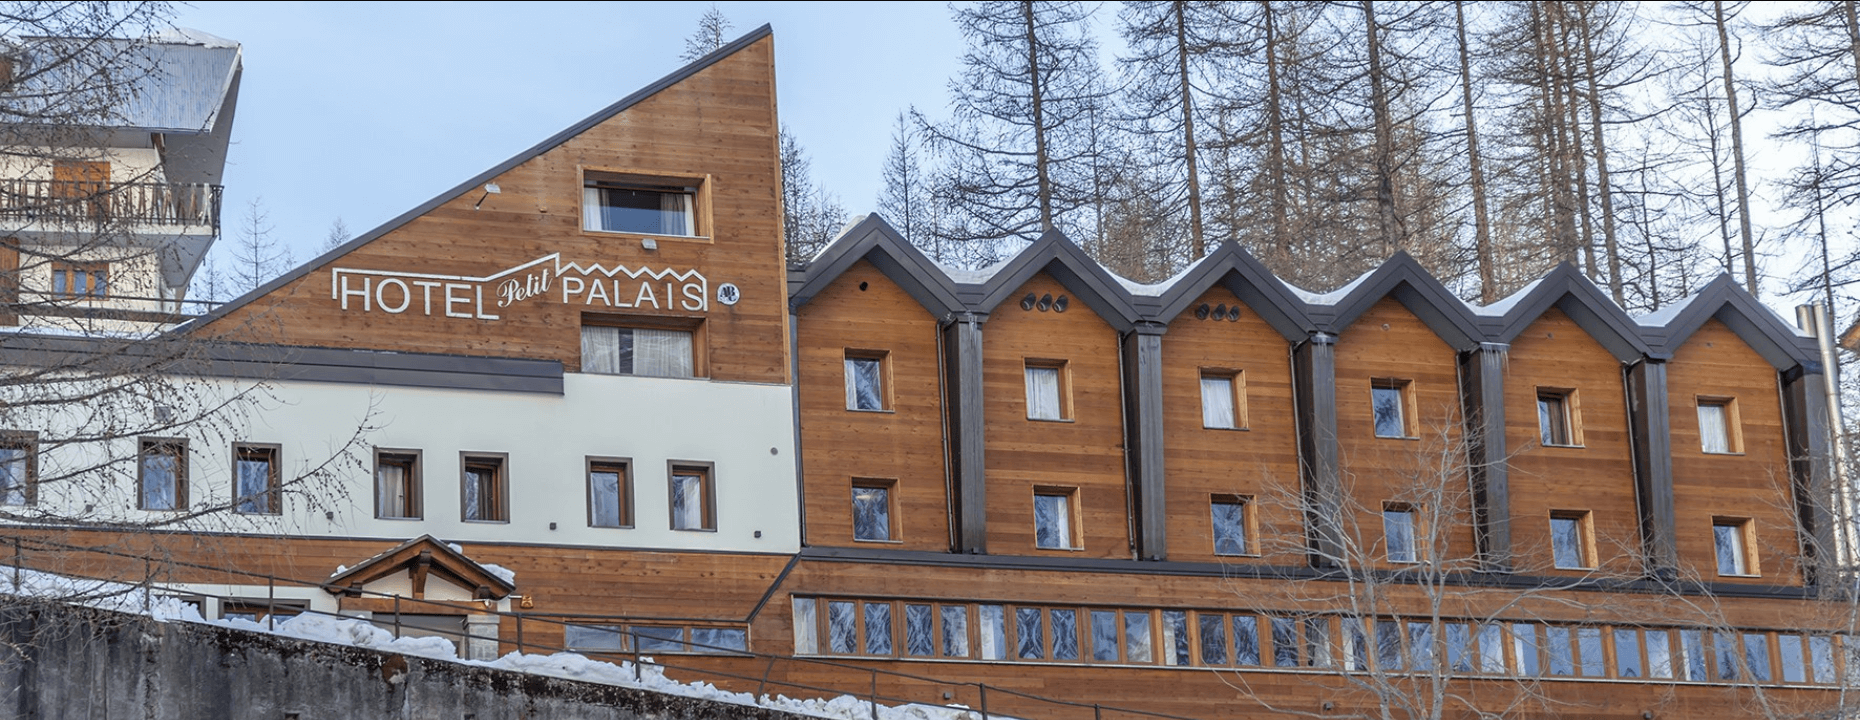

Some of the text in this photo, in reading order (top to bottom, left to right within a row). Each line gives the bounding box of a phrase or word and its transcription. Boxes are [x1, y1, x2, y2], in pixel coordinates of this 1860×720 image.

[341, 268, 704, 319] HOTEL Petit PALAIS
